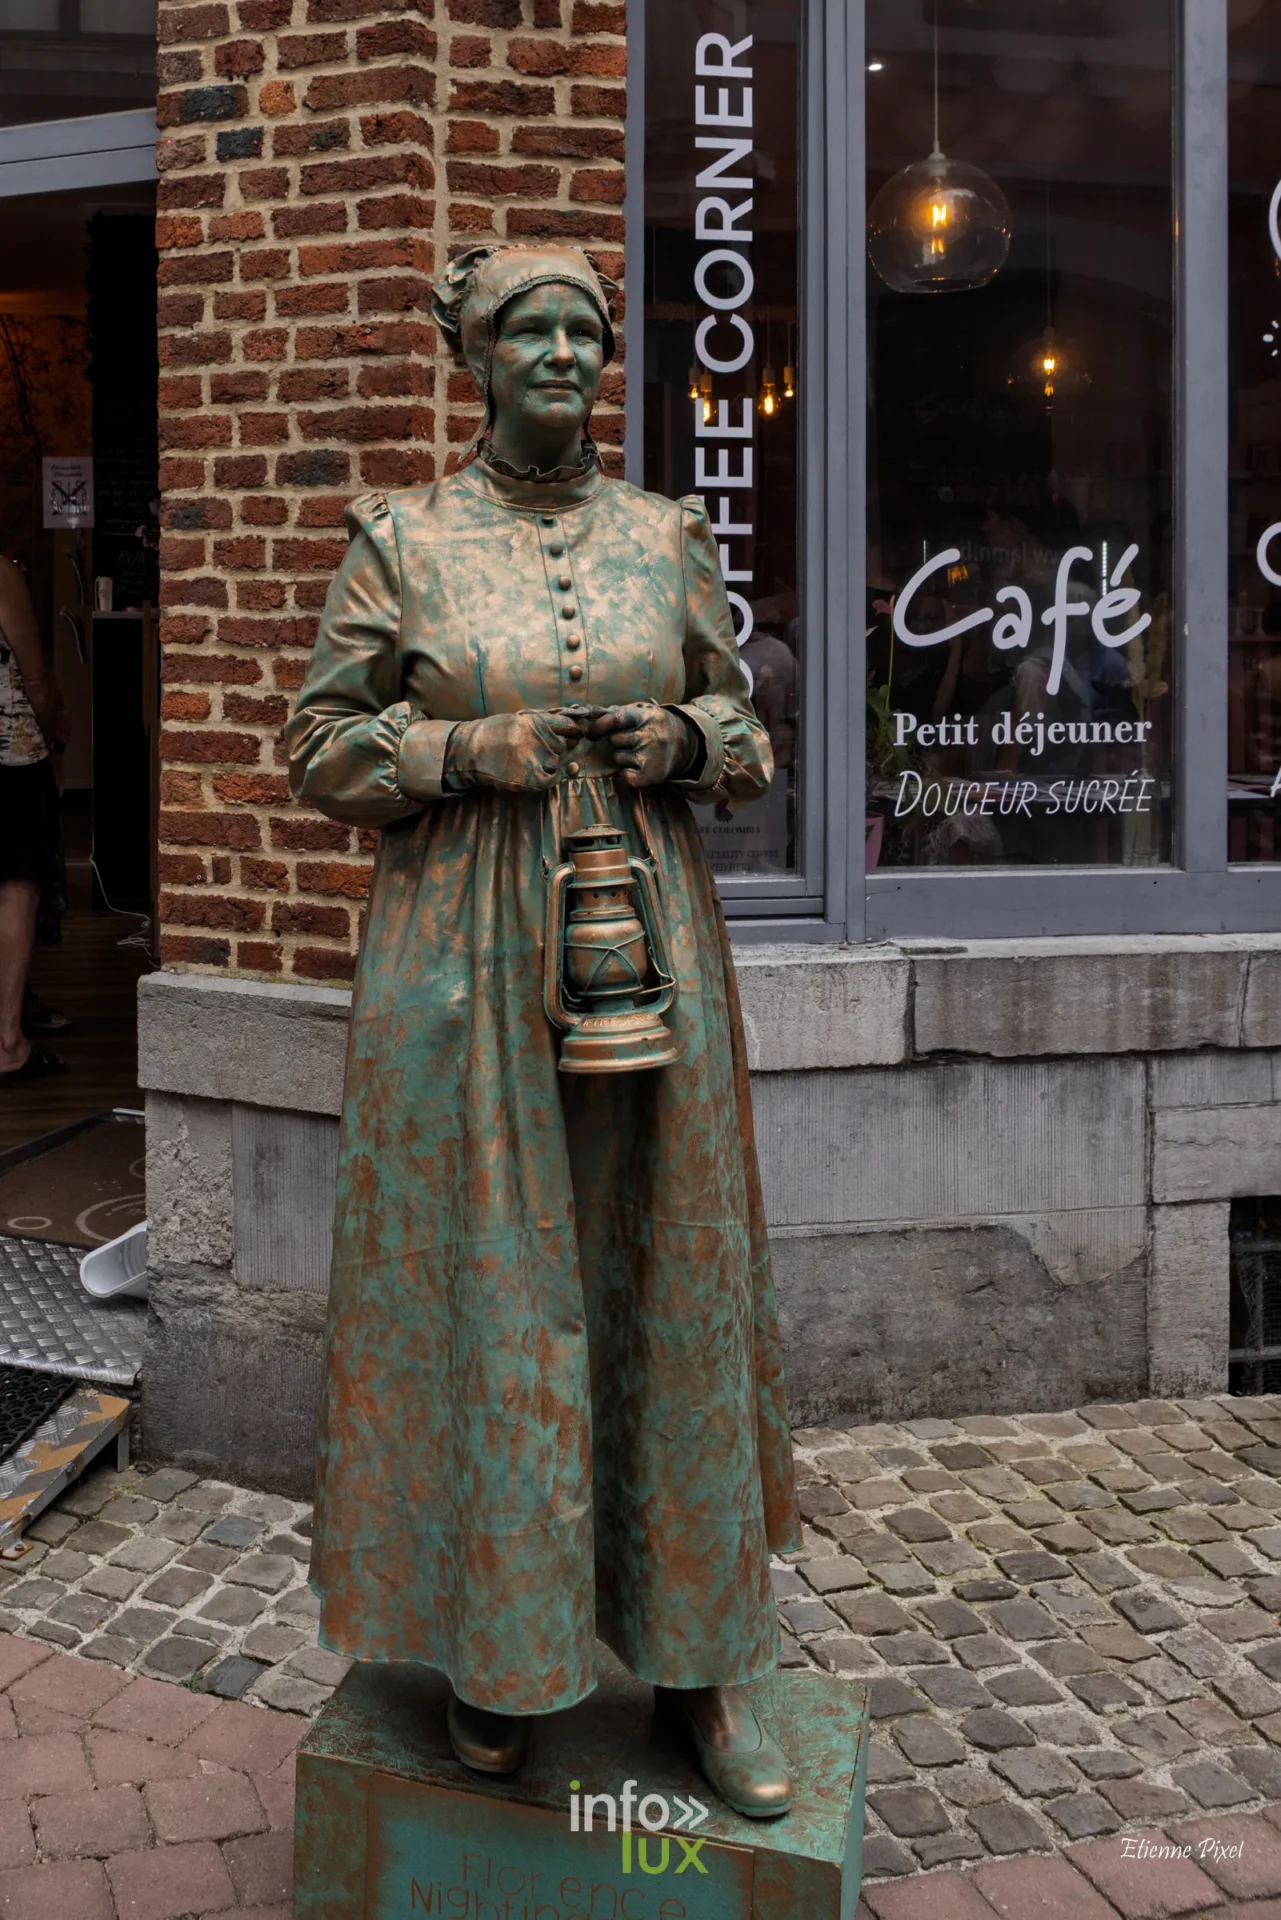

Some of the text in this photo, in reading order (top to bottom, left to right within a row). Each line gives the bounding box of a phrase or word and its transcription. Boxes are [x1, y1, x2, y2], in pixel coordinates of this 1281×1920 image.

[694, 33, 754, 699] FFEE CORNER
[893, 543, 1152, 695] Café
[893, 711, 1152, 756] Petit déjeuner
